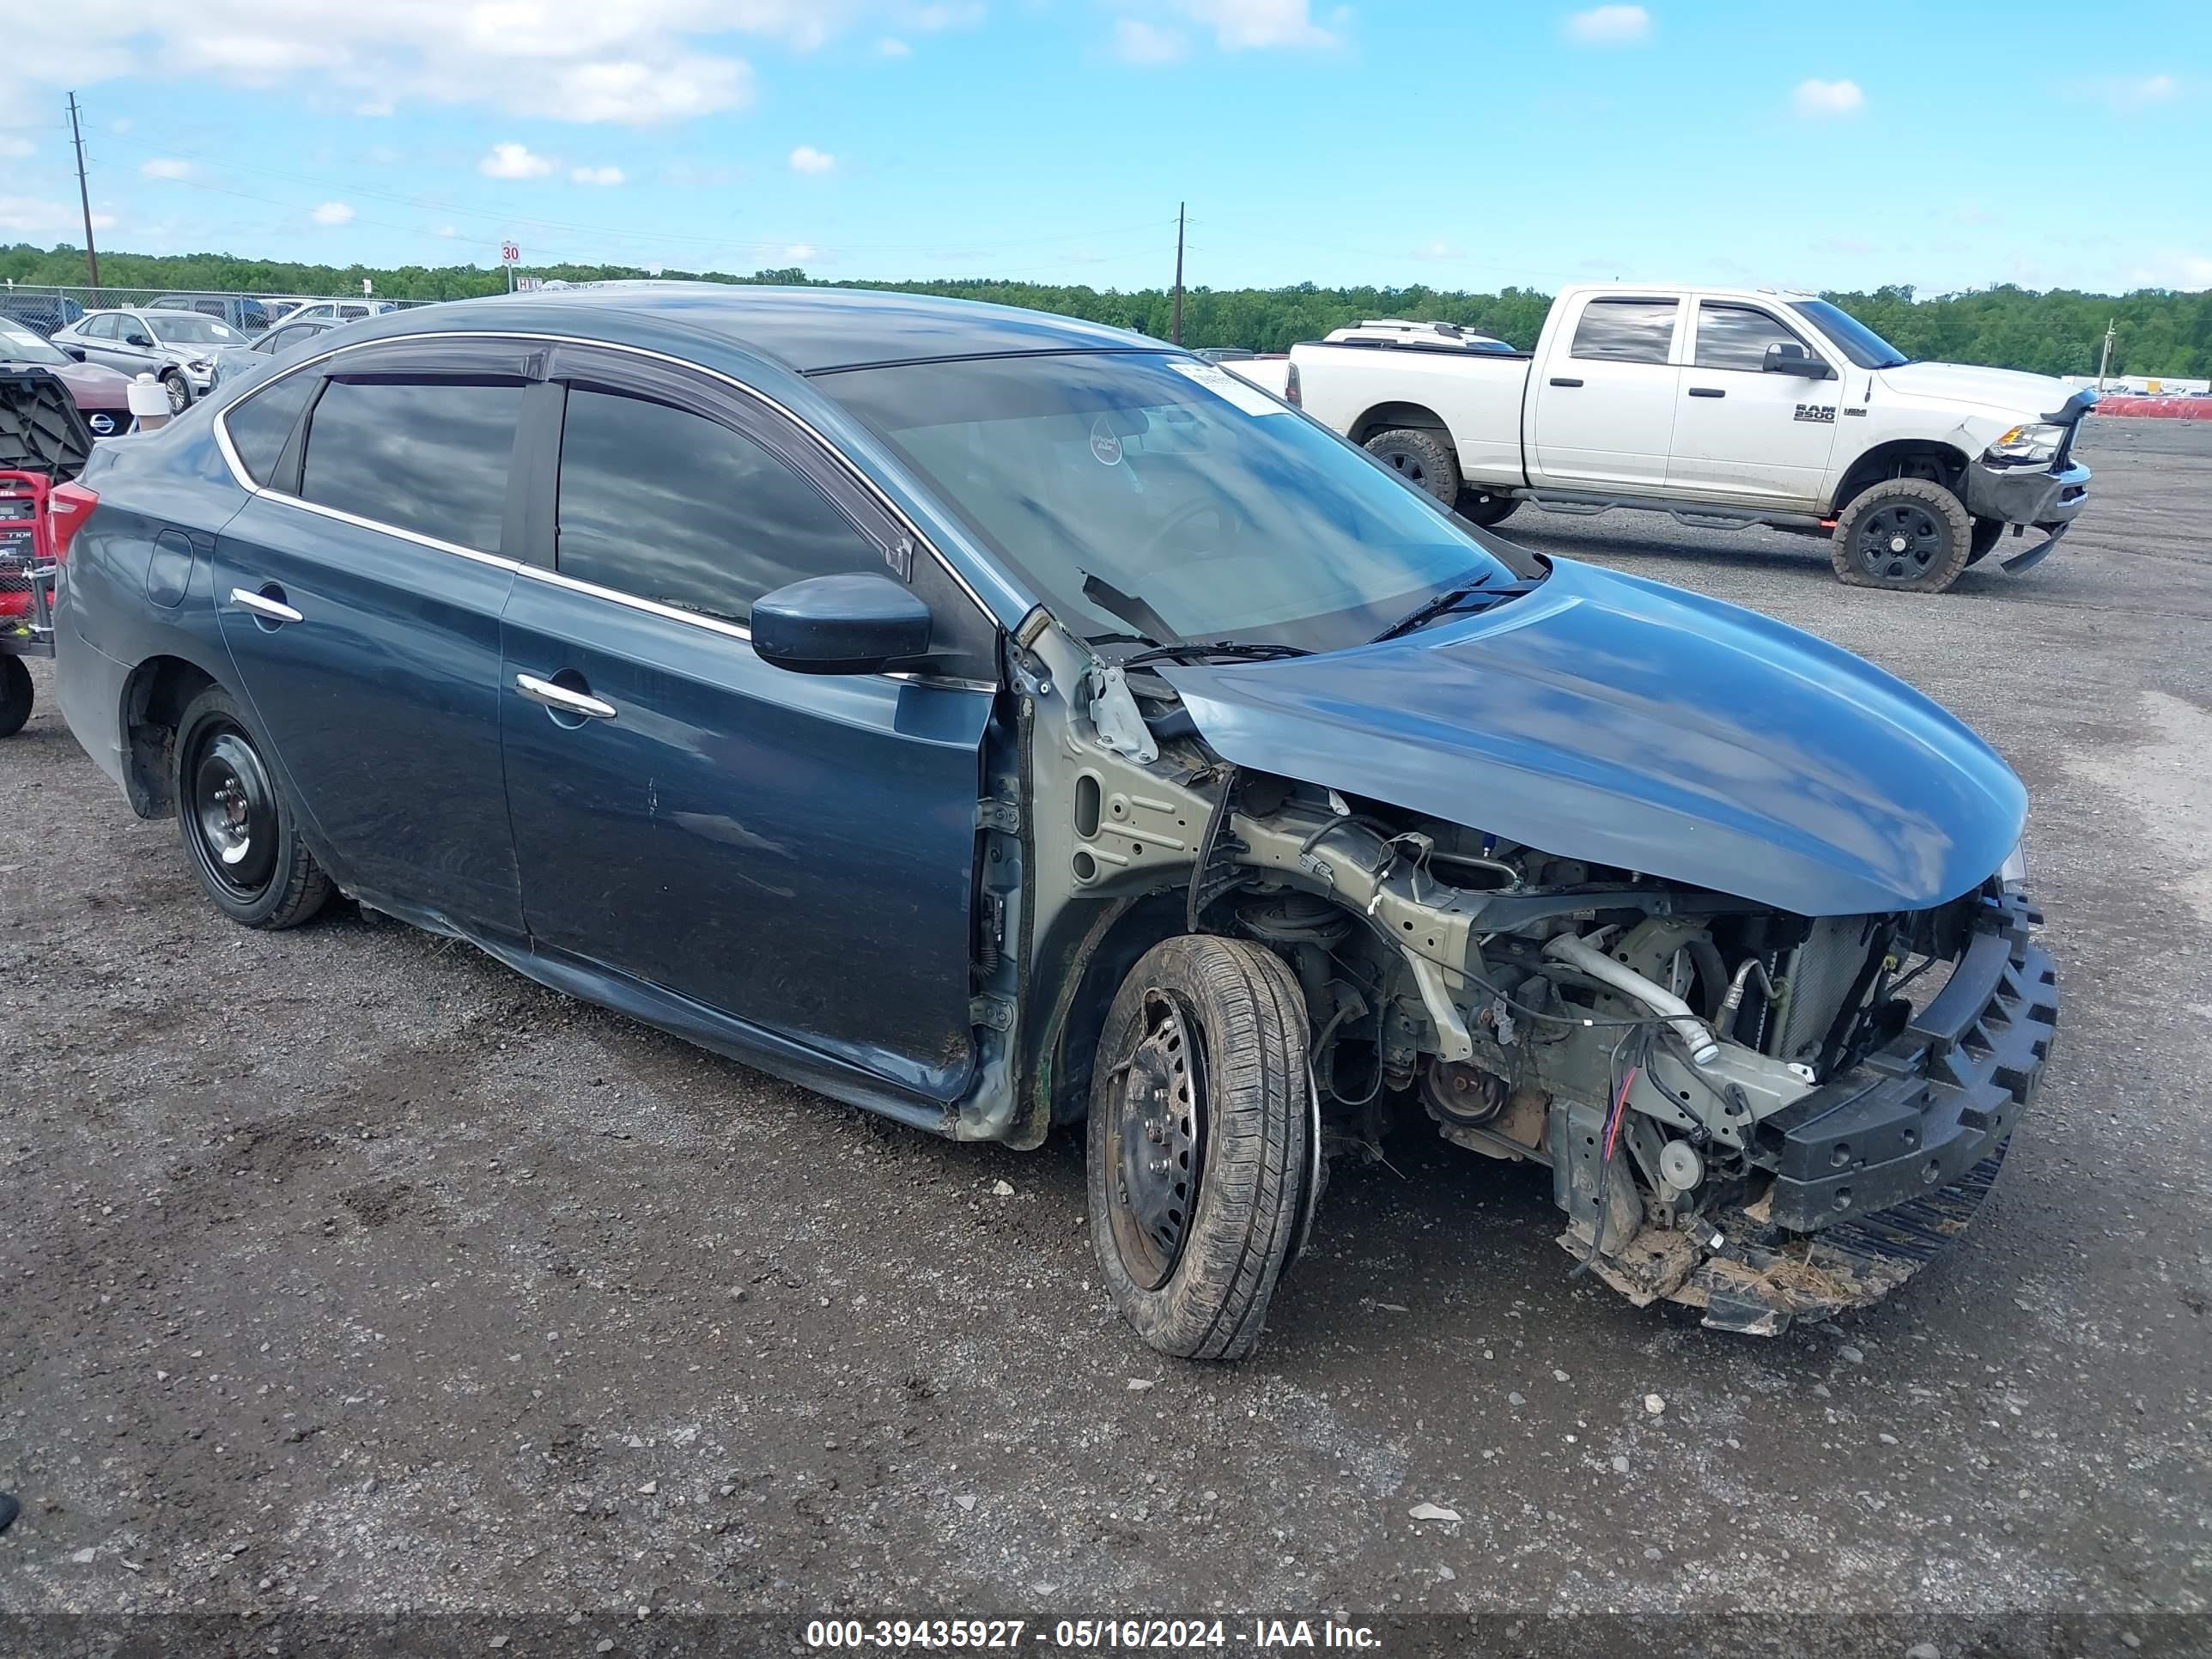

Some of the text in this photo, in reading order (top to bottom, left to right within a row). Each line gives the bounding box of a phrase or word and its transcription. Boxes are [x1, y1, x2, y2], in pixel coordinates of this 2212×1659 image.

[503, 246, 519, 260] 30
[1796, 404, 1837, 413] RAM
[1794, 410, 1836, 420] 2500
